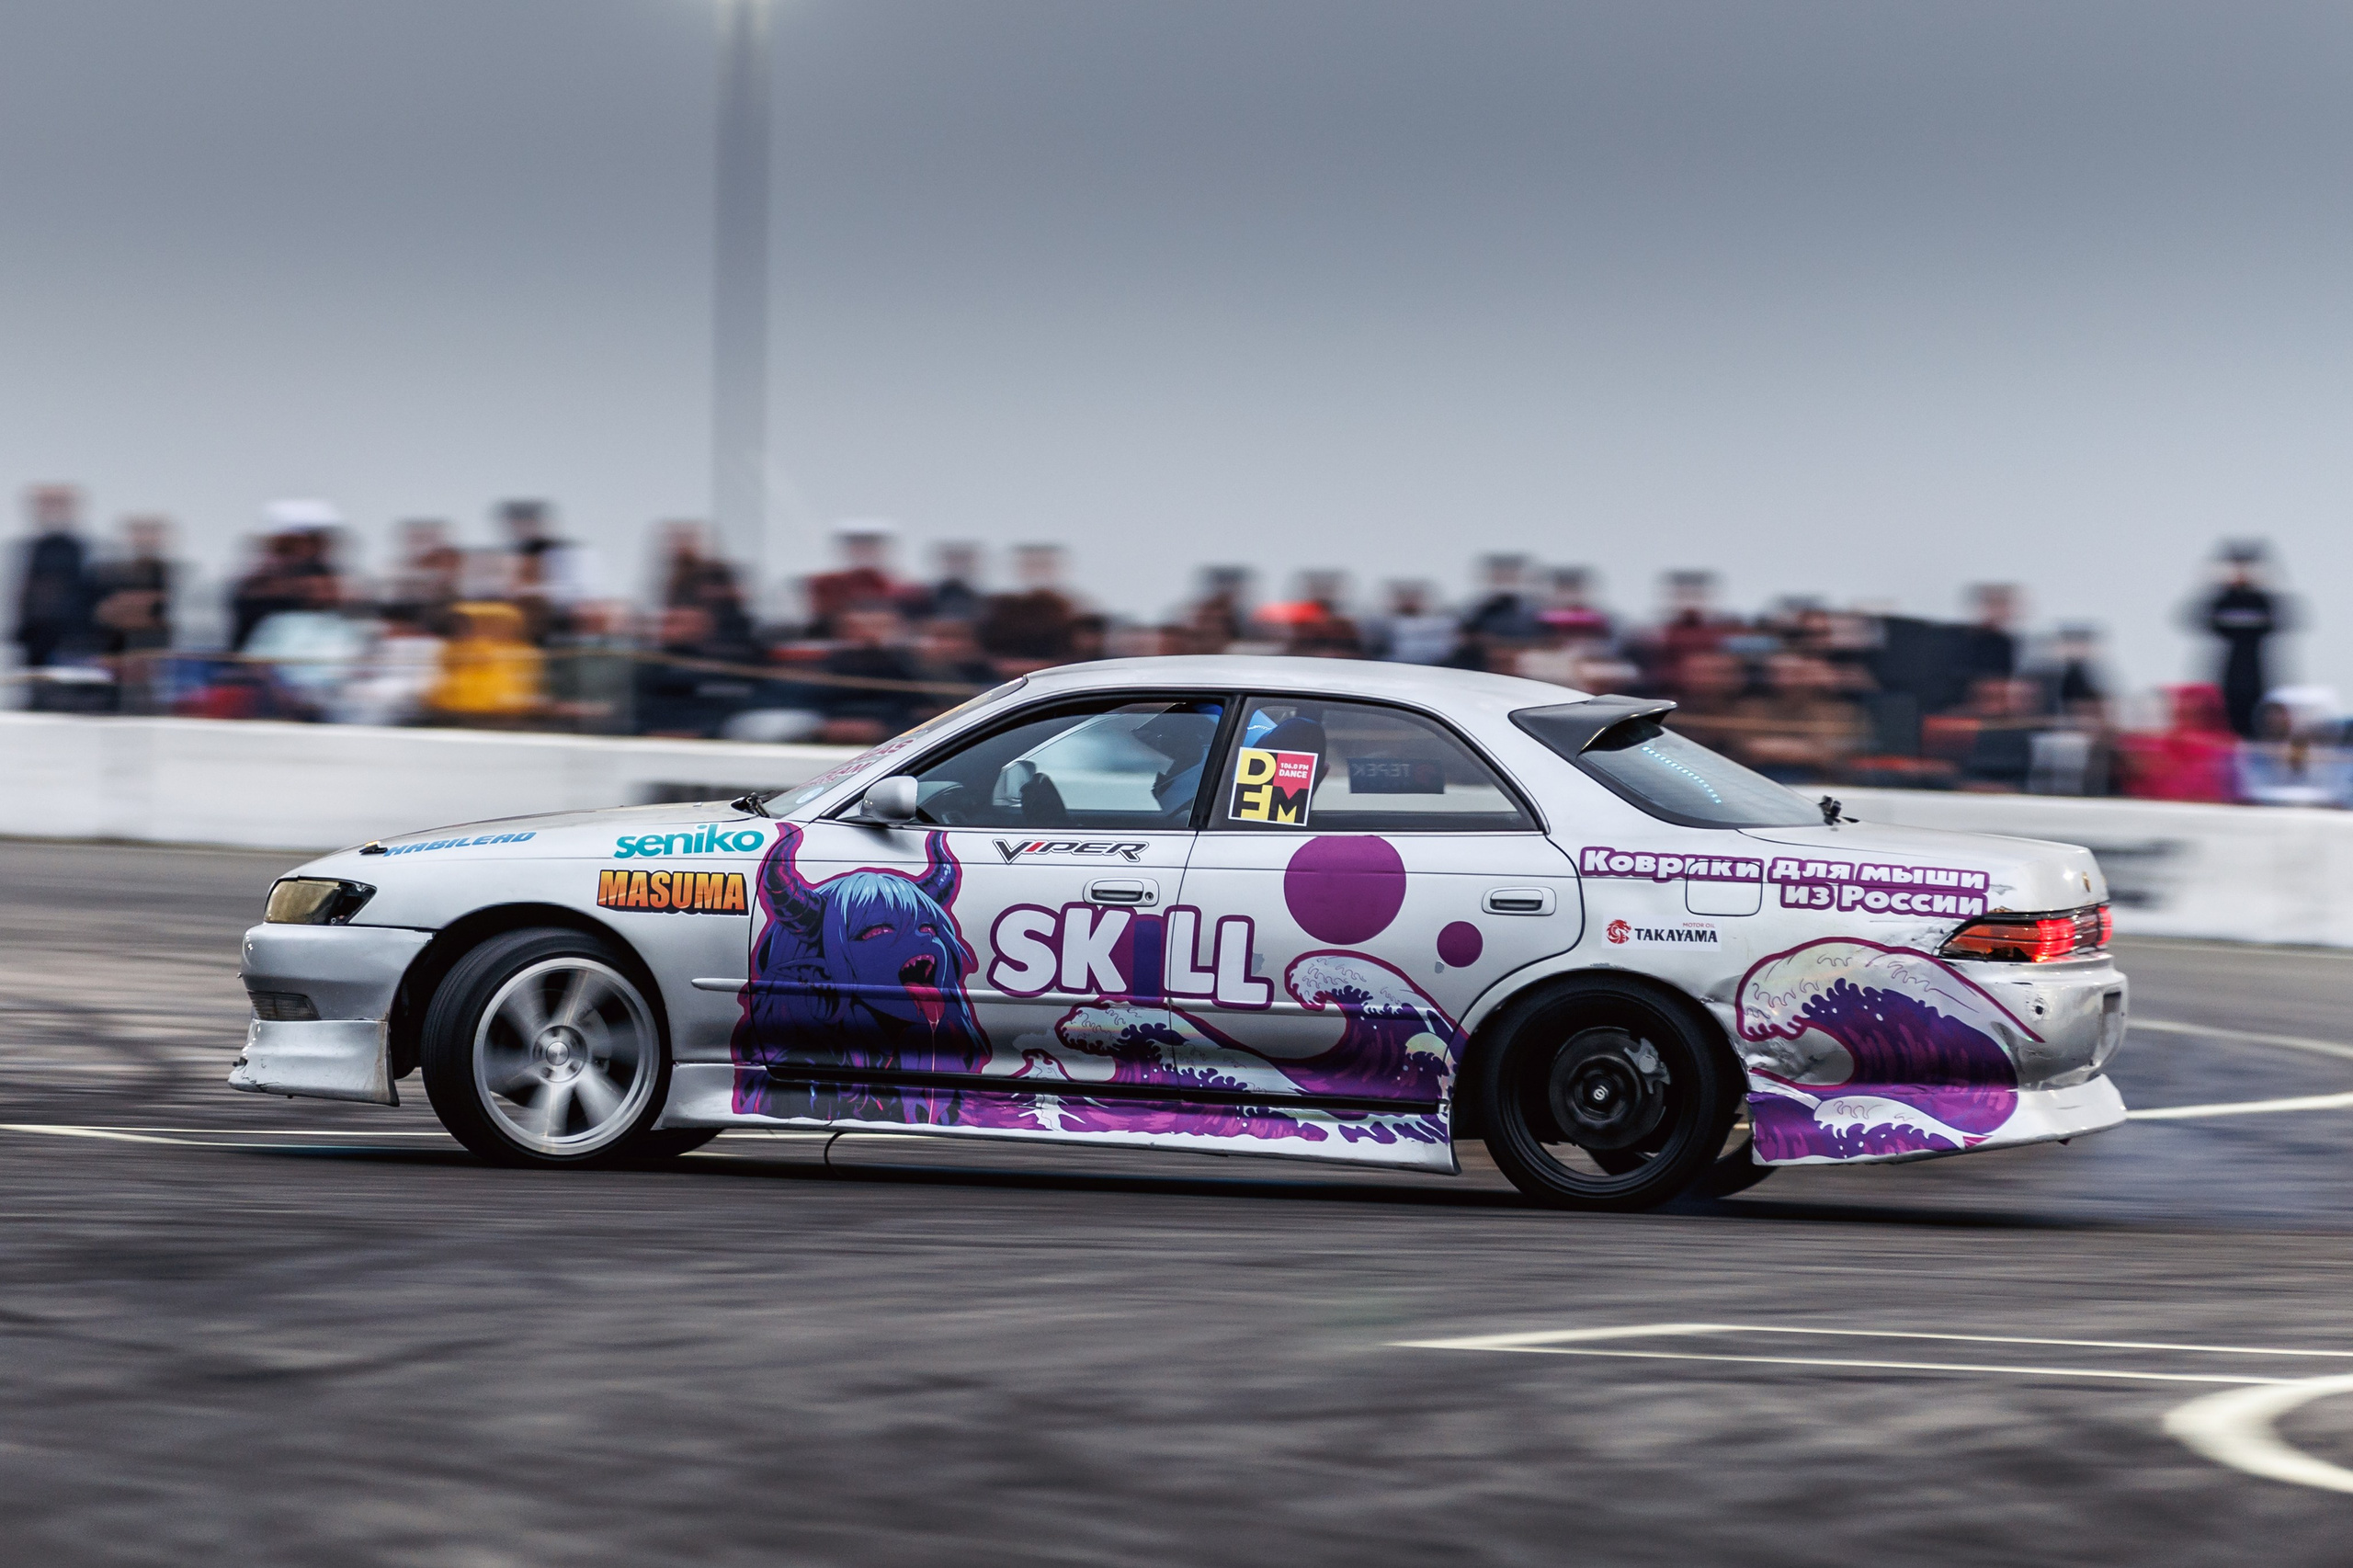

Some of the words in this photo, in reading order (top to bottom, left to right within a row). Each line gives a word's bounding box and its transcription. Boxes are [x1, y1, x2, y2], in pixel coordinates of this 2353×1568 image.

[1279, 768, 1308, 778] DANCE
[1280, 762, 1298, 770] 106.0
[382, 832, 537, 858] HABILEAD
[614, 824, 765, 858] seniko
[994, 840, 1148, 864] VIPER
[1583, 849, 1761, 880] Коврики
[1771, 858, 1851, 881] для
[1859, 865, 1985, 890] мыши
[597, 869, 746, 912] MASUMA
[1784, 884, 1831, 905] из
[1841, 884, 1984, 916] России
[1634, 927, 1719, 943] TAKAYAMA
[990, 905, 1270, 1006] SKILL
